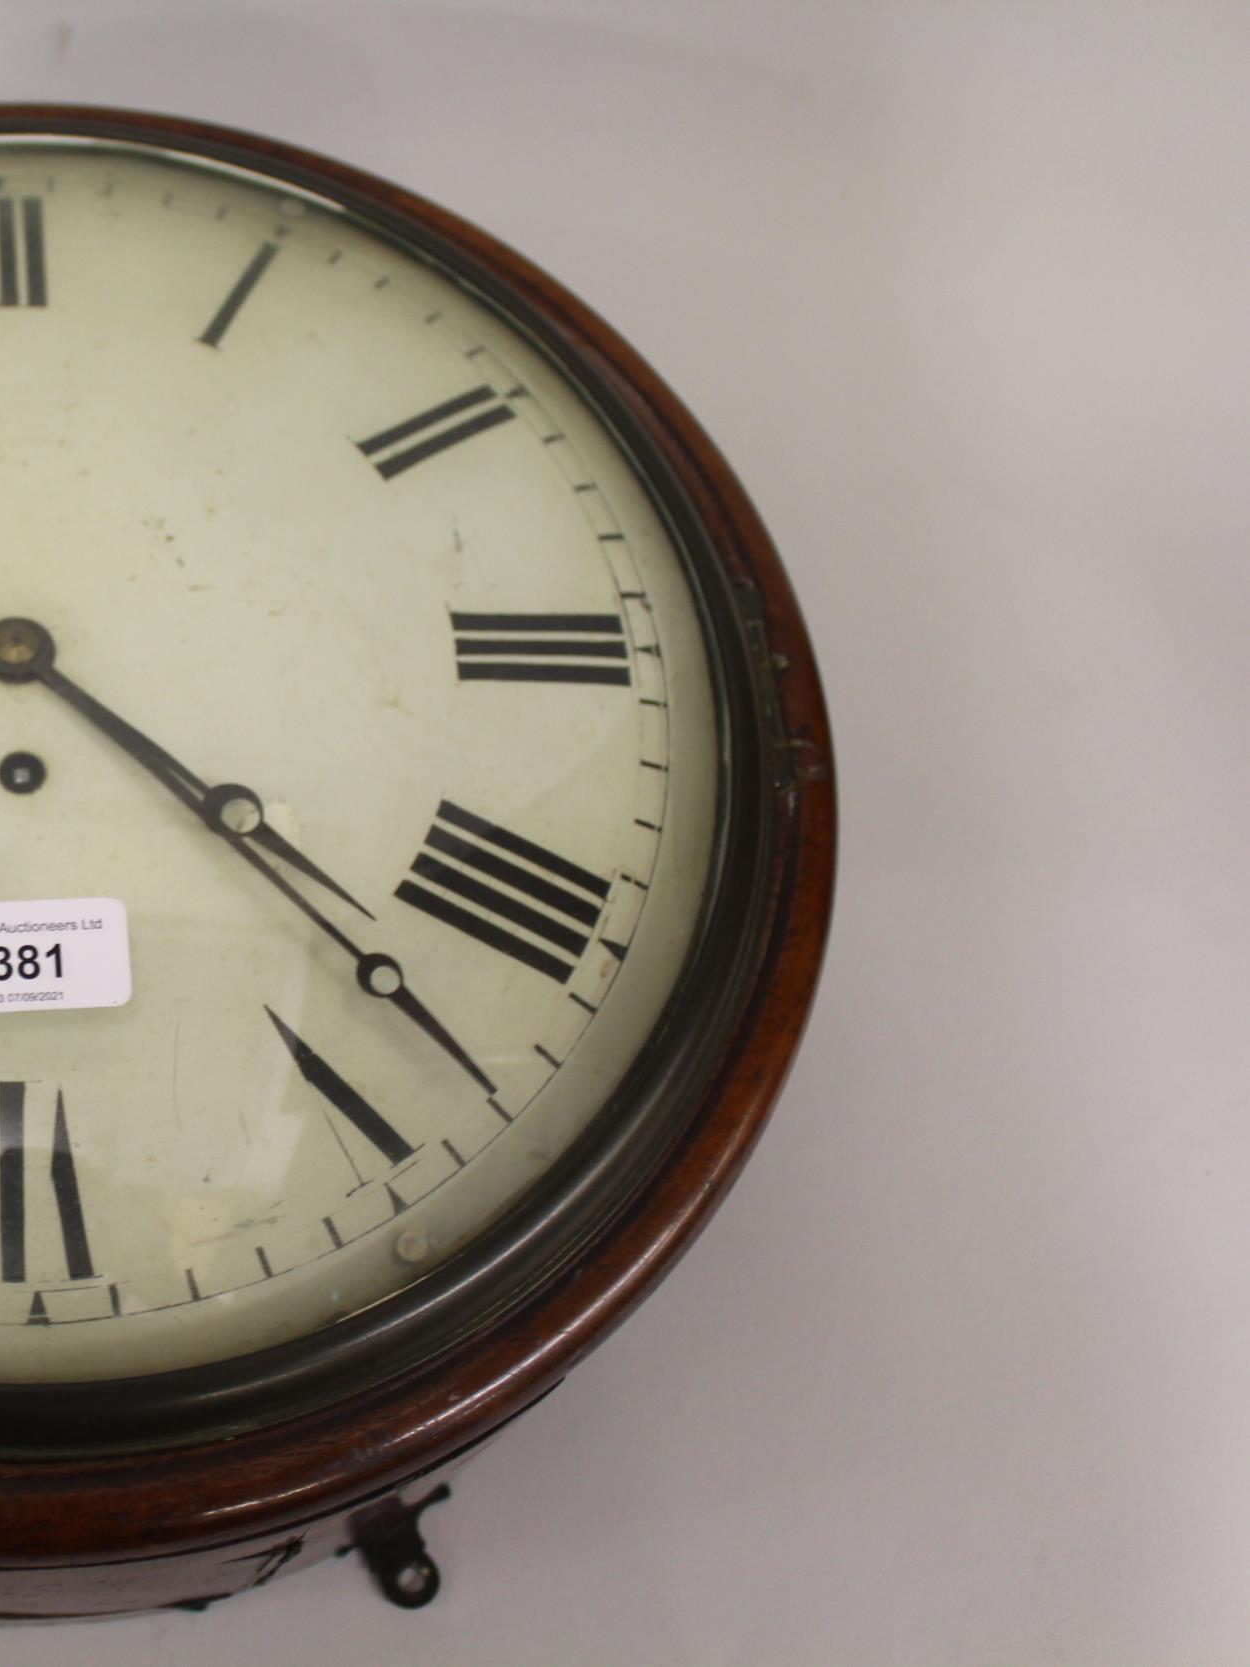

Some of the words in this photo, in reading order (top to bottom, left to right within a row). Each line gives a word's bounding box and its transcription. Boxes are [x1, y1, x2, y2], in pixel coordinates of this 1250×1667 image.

[353, 382, 518, 482] II
[448, 610, 632, 686] III
[81, 918, 103, 931] Ltd
[393, 799, 611, 985] IIII
[7, 991, 64, 1004] 07/09/2021
